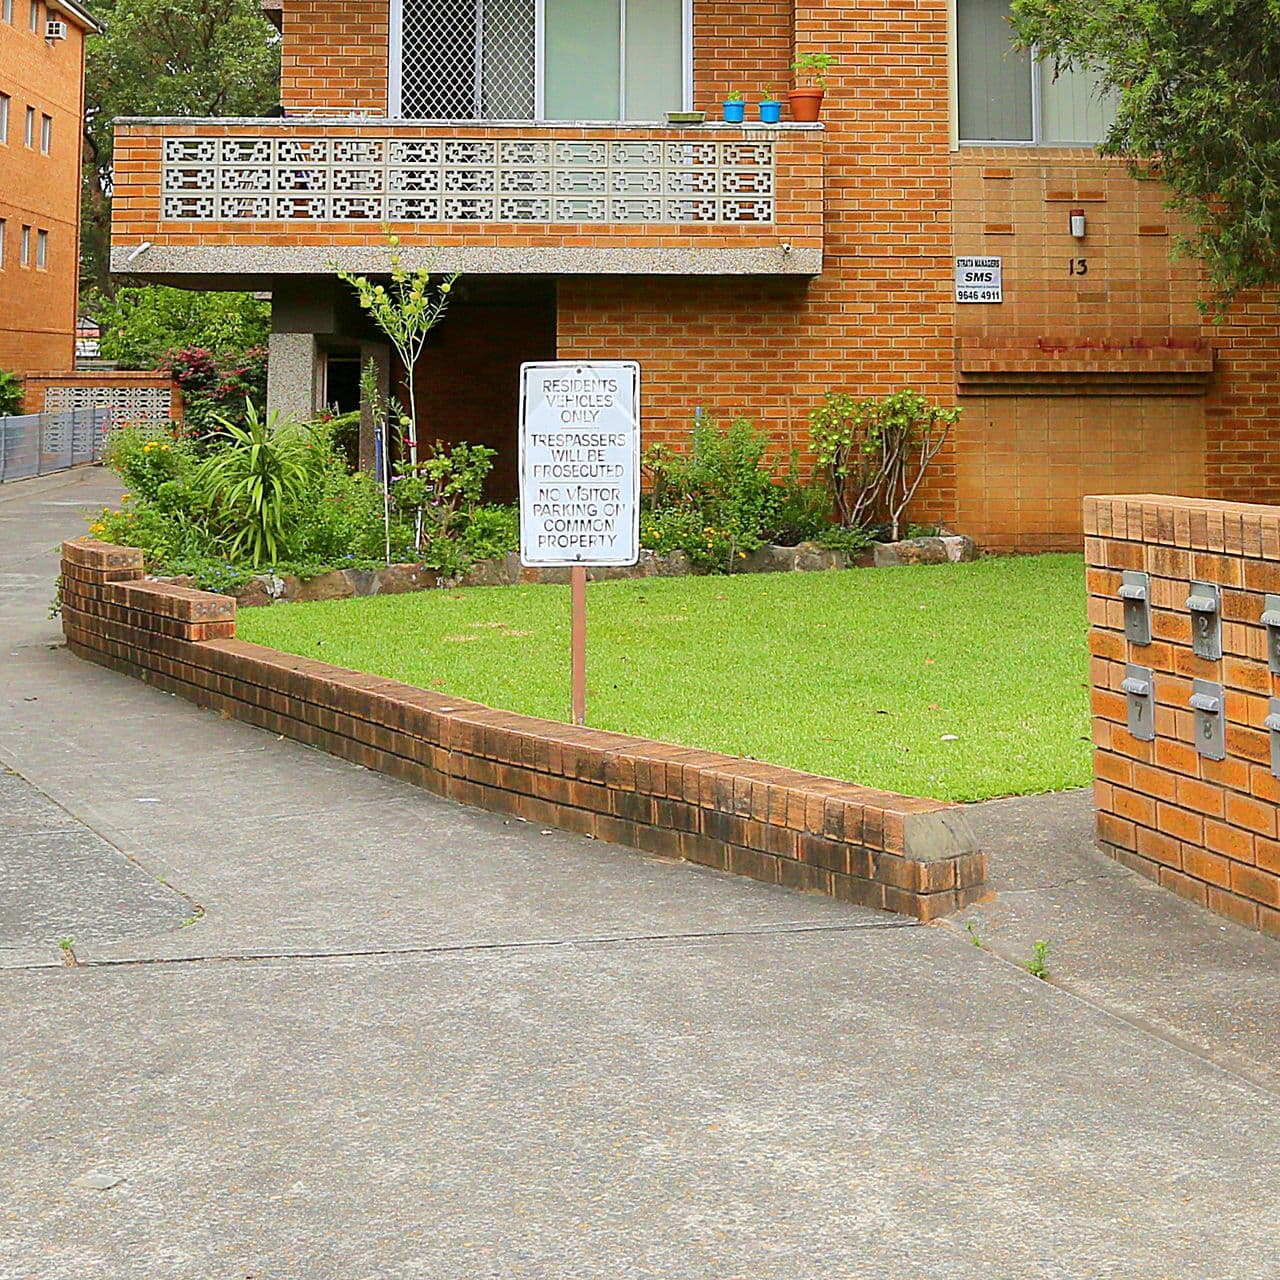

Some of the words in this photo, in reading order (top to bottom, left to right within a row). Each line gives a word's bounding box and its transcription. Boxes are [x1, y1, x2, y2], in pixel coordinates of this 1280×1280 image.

[1069, 258, 1088, 276] 13
[965, 272, 993, 282] SMS
[980, 290, 1000, 300] 4911
[543, 379, 618, 393] RESIDENTS
[546, 394, 614, 408] VEHICLES
[560, 409, 600, 423] ONLY
[531, 433, 626, 447] TRESPASSERS
[552, 449, 583, 462] WILL
[587, 449, 606, 462] BE
[533, 464, 625, 478] PROSECUTED
[539, 488, 561, 501] NO
[566, 487, 621, 502] VISITOR
[533, 503, 598, 517] PARKING
[603, 503, 626, 517] ON
[544, 519, 615, 532] COMMON
[538, 534, 618, 548] PROPERTY
[1198, 616, 1209, 639] 2
[1134, 701, 1143, 722] 7
[1203, 719, 1213, 740] 8
